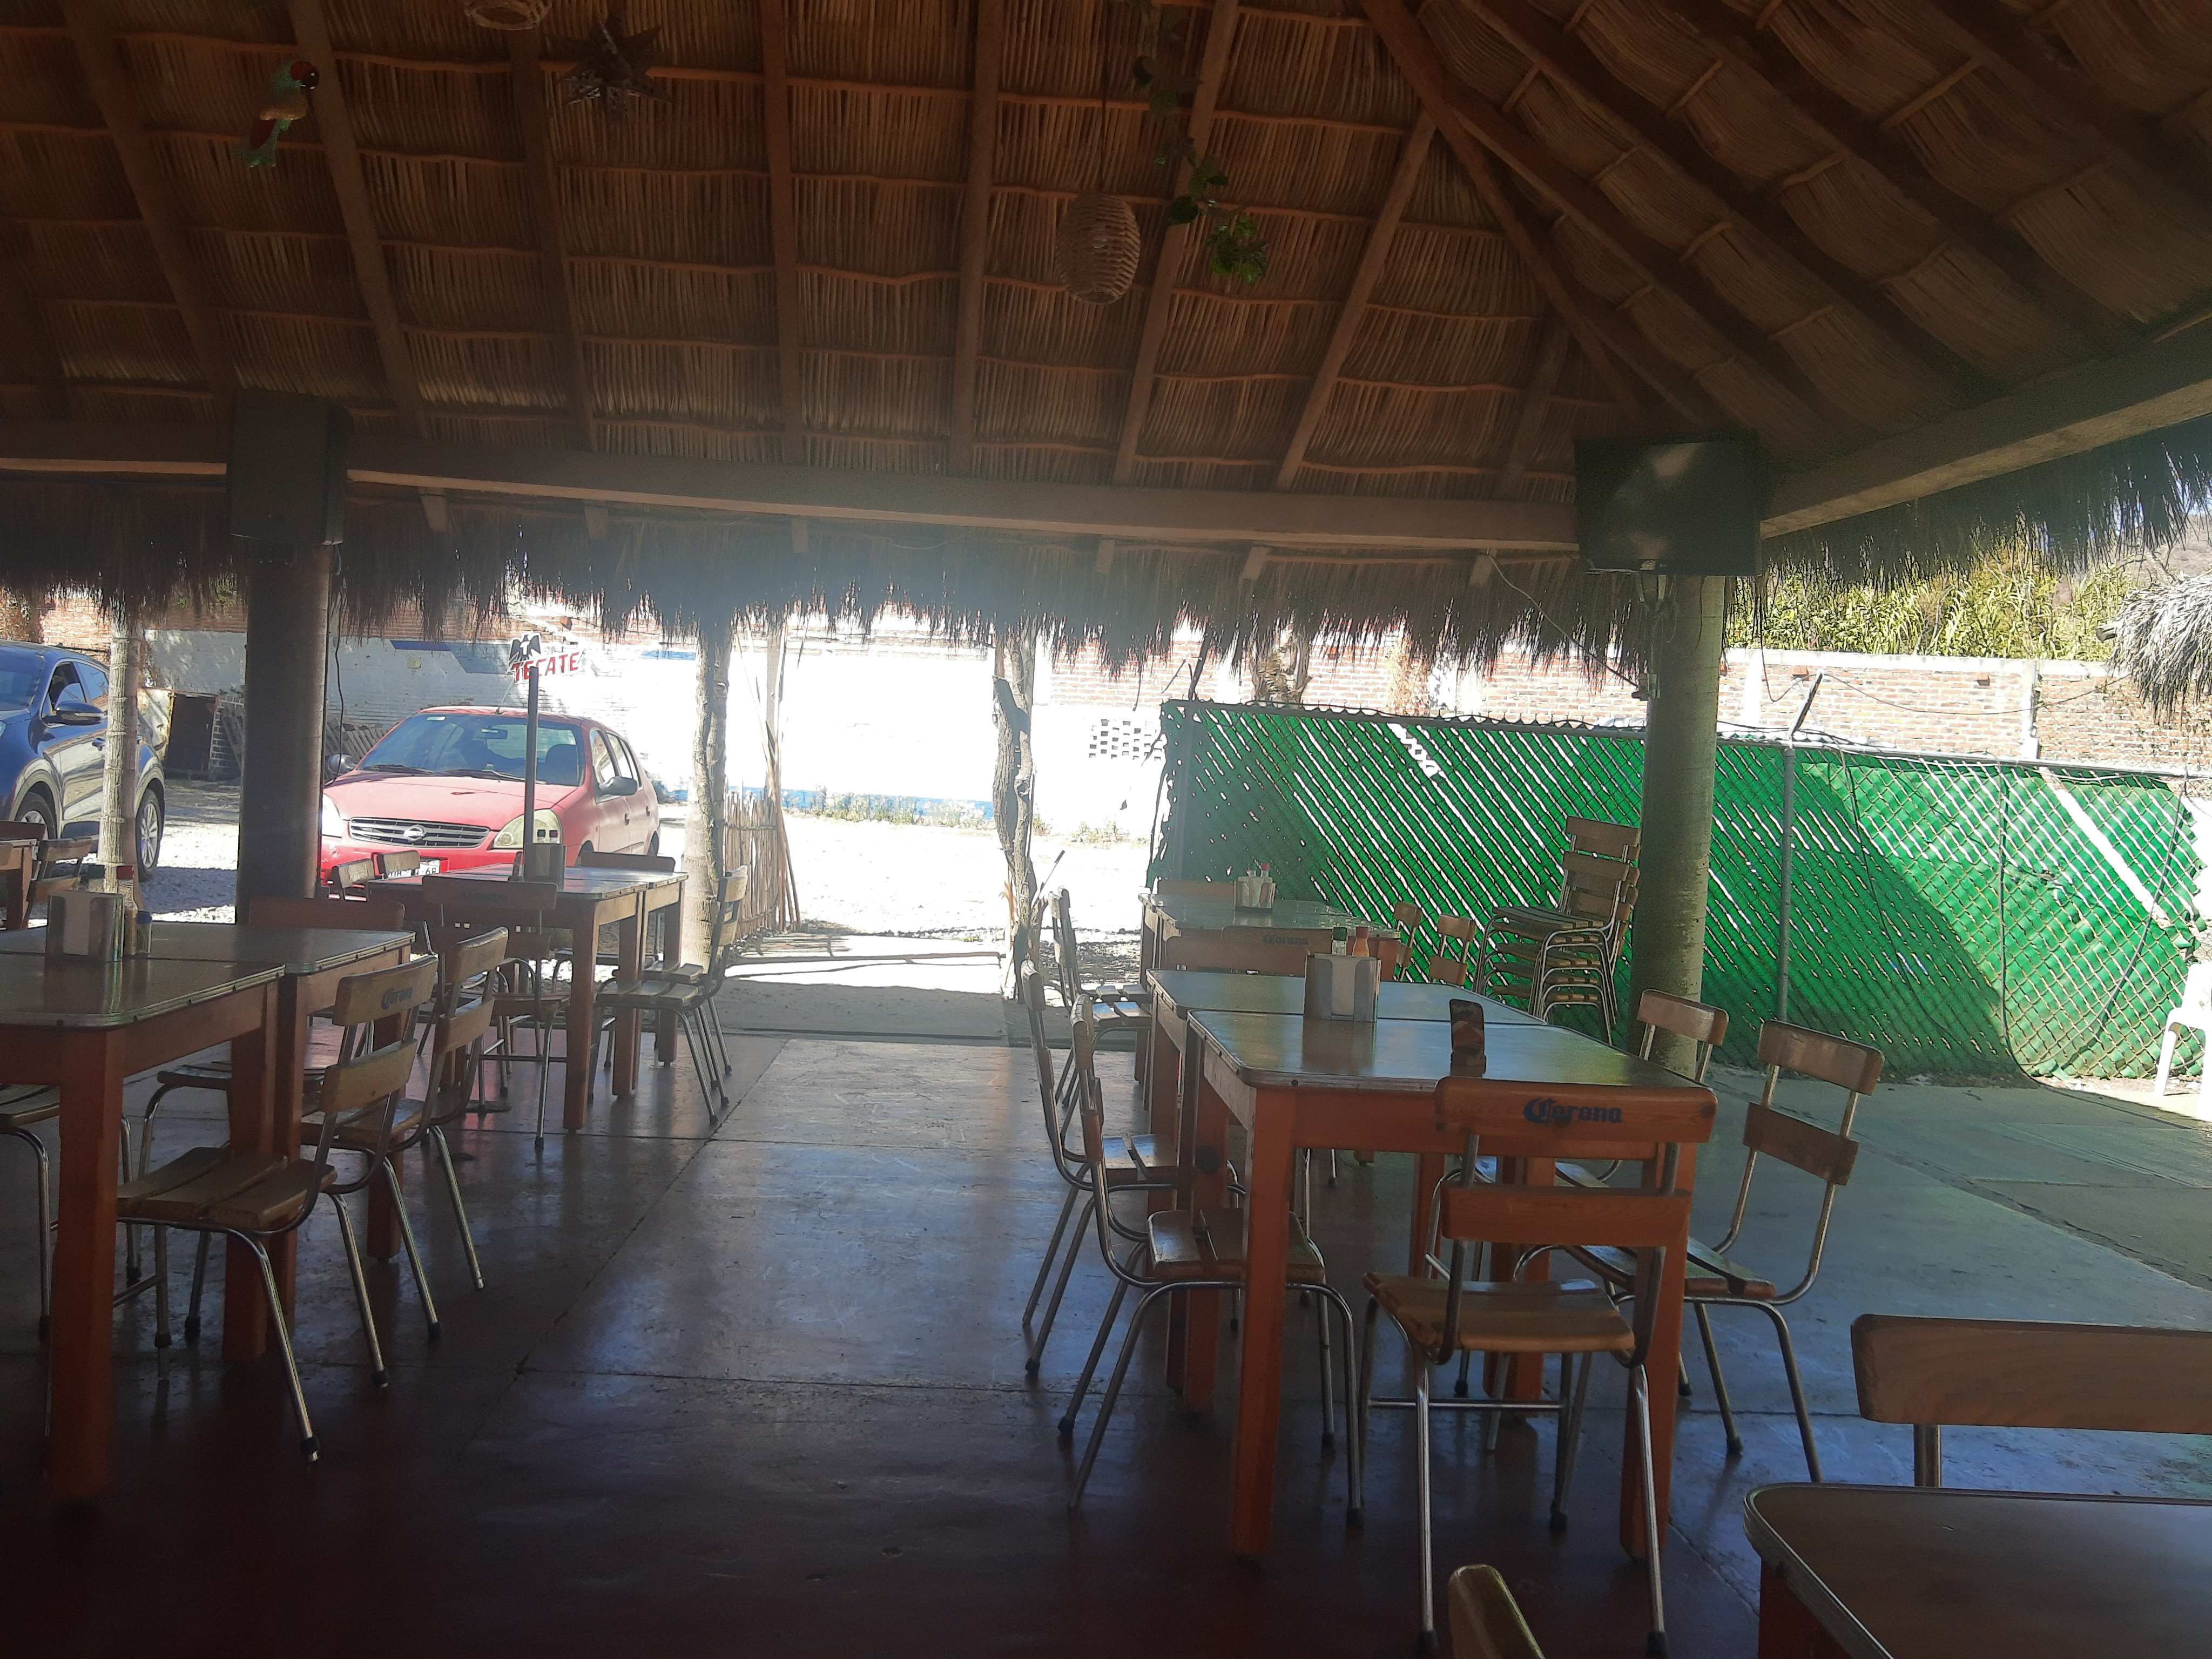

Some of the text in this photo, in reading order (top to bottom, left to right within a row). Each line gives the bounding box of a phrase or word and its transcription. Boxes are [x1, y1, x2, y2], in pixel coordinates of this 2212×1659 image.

[510, 652, 579, 682] TECATE
[1263, 934, 1308, 946] Corona
[381, 987, 413, 1009] Corona
[1523, 1097, 1623, 1125] Corona
